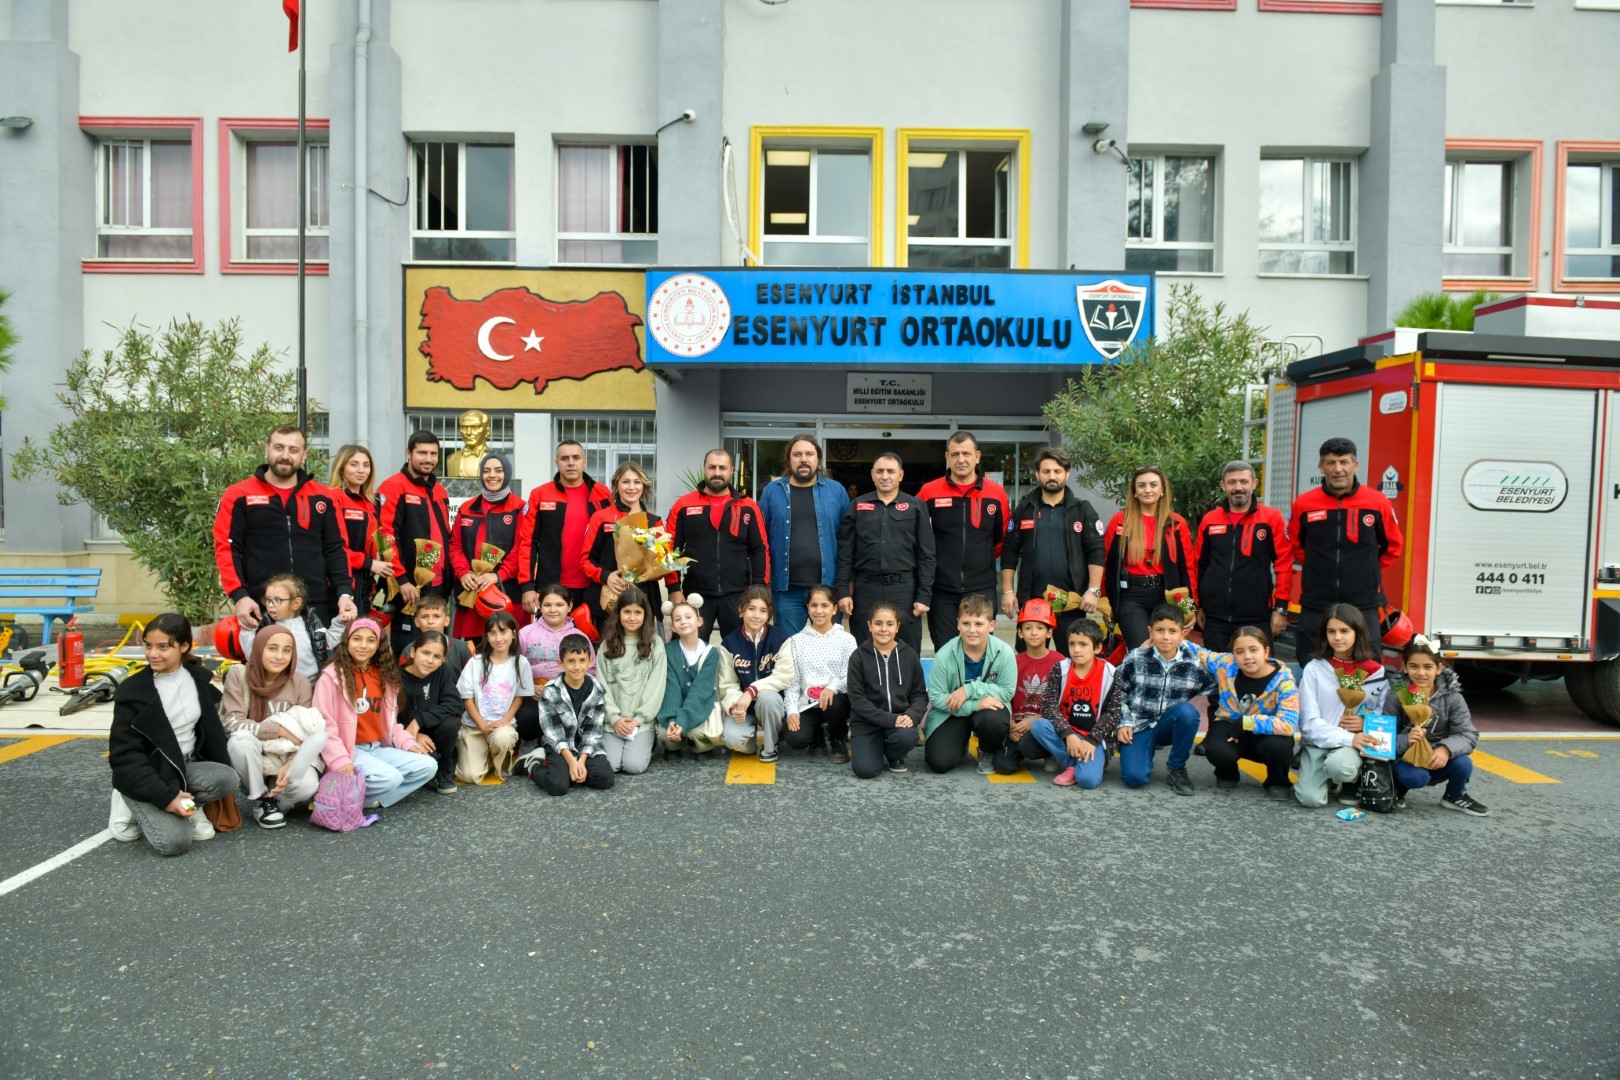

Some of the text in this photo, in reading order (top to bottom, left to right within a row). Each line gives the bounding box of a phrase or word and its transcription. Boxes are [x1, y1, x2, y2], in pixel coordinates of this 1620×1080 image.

[757, 279, 996, 305] ESENYURT İSTANBUL
[733, 315, 1072, 349] ESENYURT ORTAOKULU
[879, 379, 901, 387] T.C.
[853, 387, 926, 396] MİLLİ EĞİTİM BAKANLIĞI
[854, 397, 925, 406] ESENYURT ORTAOKULU
[1499, 486, 1556, 496] ESENYURT
[1496, 495, 1556, 505] BELEDİYESİ
[1475, 561, 1548, 570] www.esenyurt.bel.tr
[1476, 572, 1545, 585] 444 0 411
[1070, 687, 1093, 697] BOO!
